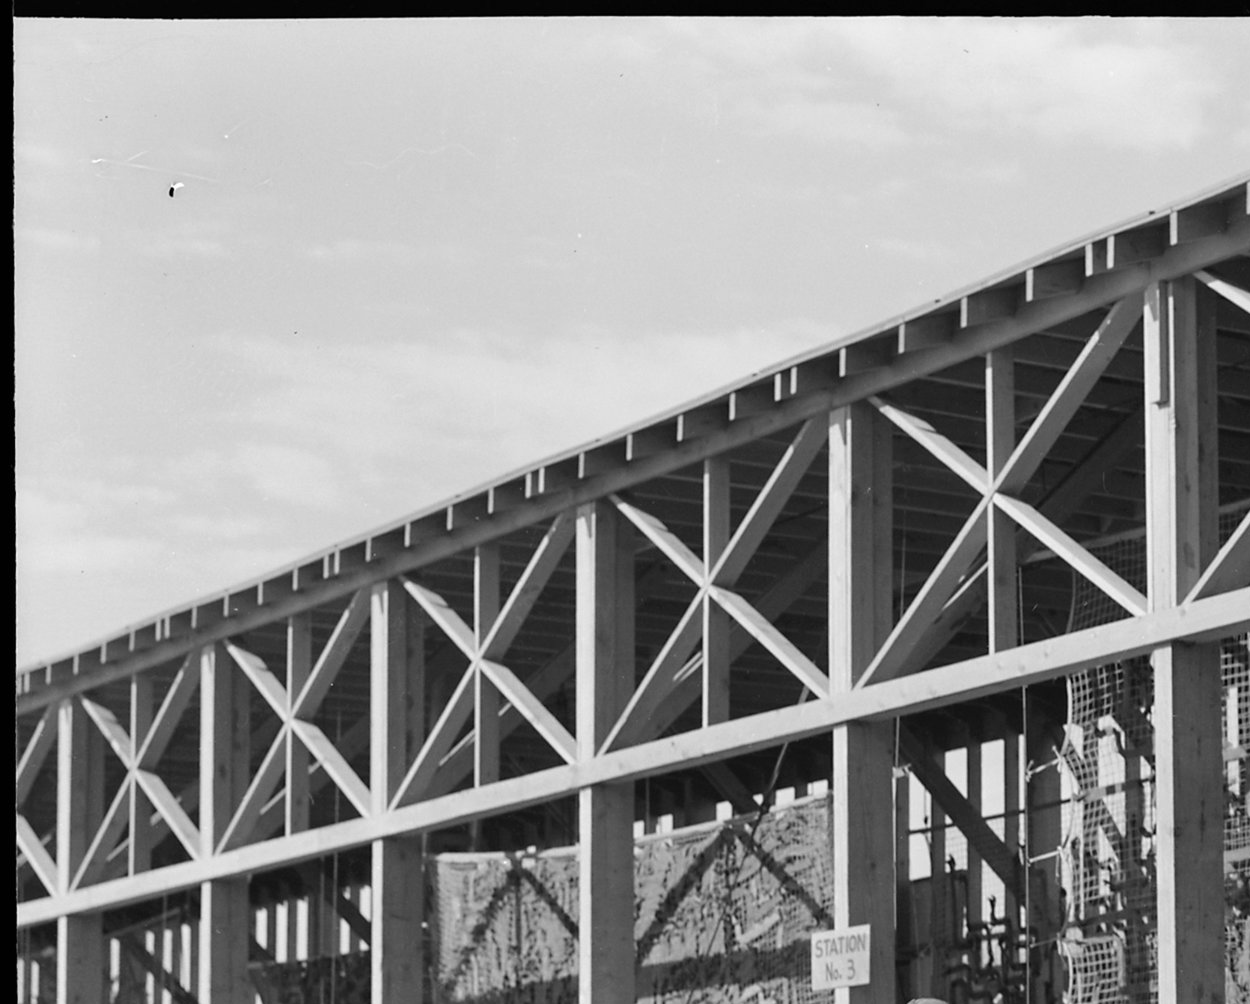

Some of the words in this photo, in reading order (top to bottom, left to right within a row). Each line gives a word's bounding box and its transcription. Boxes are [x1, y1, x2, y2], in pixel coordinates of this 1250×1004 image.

[815, 933, 866, 958] STATION
[826, 961, 842, 981] No.
[847, 959, 856, 980] 3
